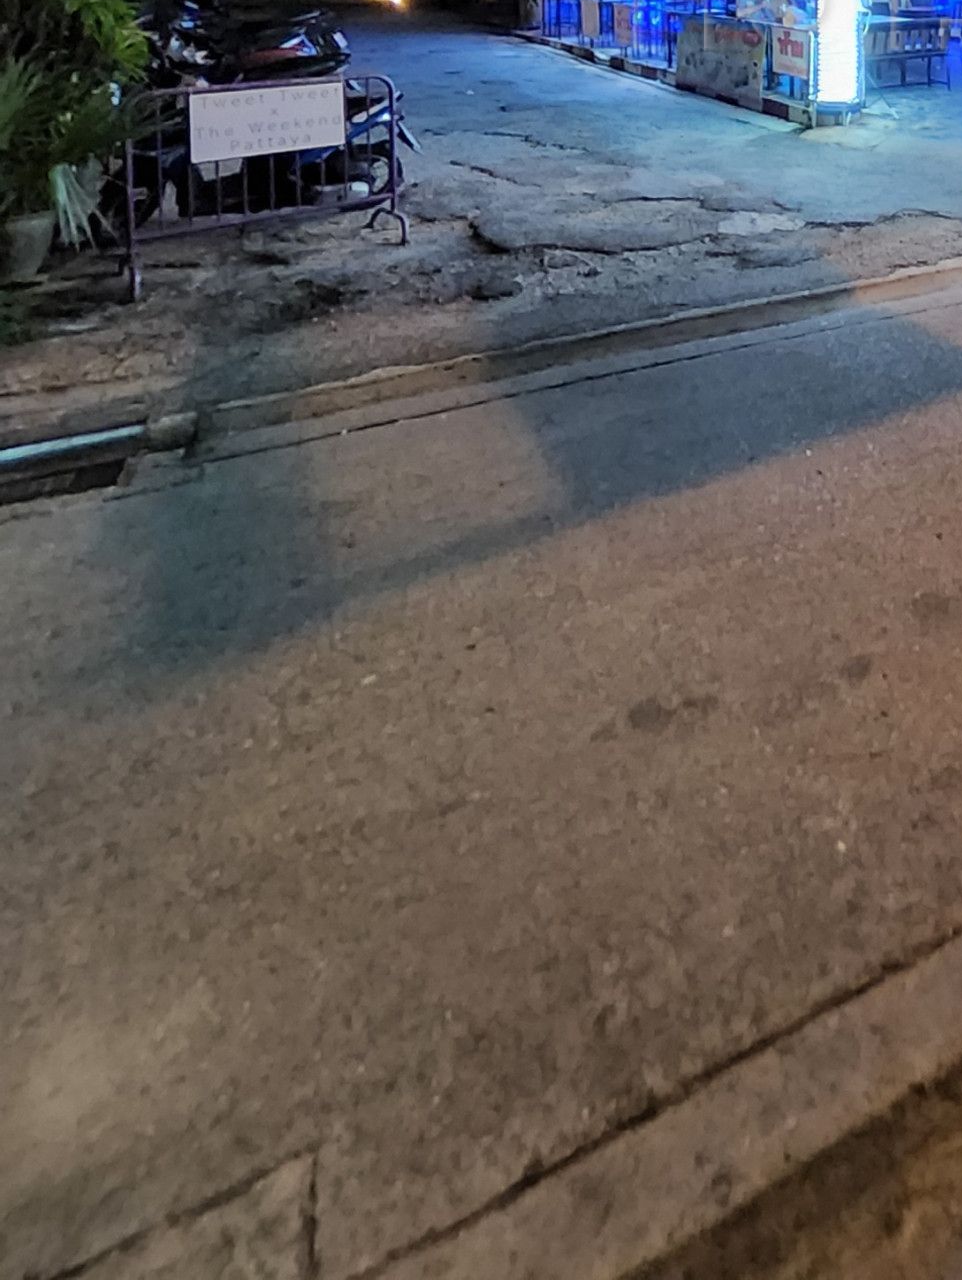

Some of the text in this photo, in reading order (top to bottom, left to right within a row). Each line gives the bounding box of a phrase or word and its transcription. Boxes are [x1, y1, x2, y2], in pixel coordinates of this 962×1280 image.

[201, 87, 338, 110] Tweet Tweet
[195, 114, 341, 140] The Weekend
[230, 134, 311, 152] Pattaya
